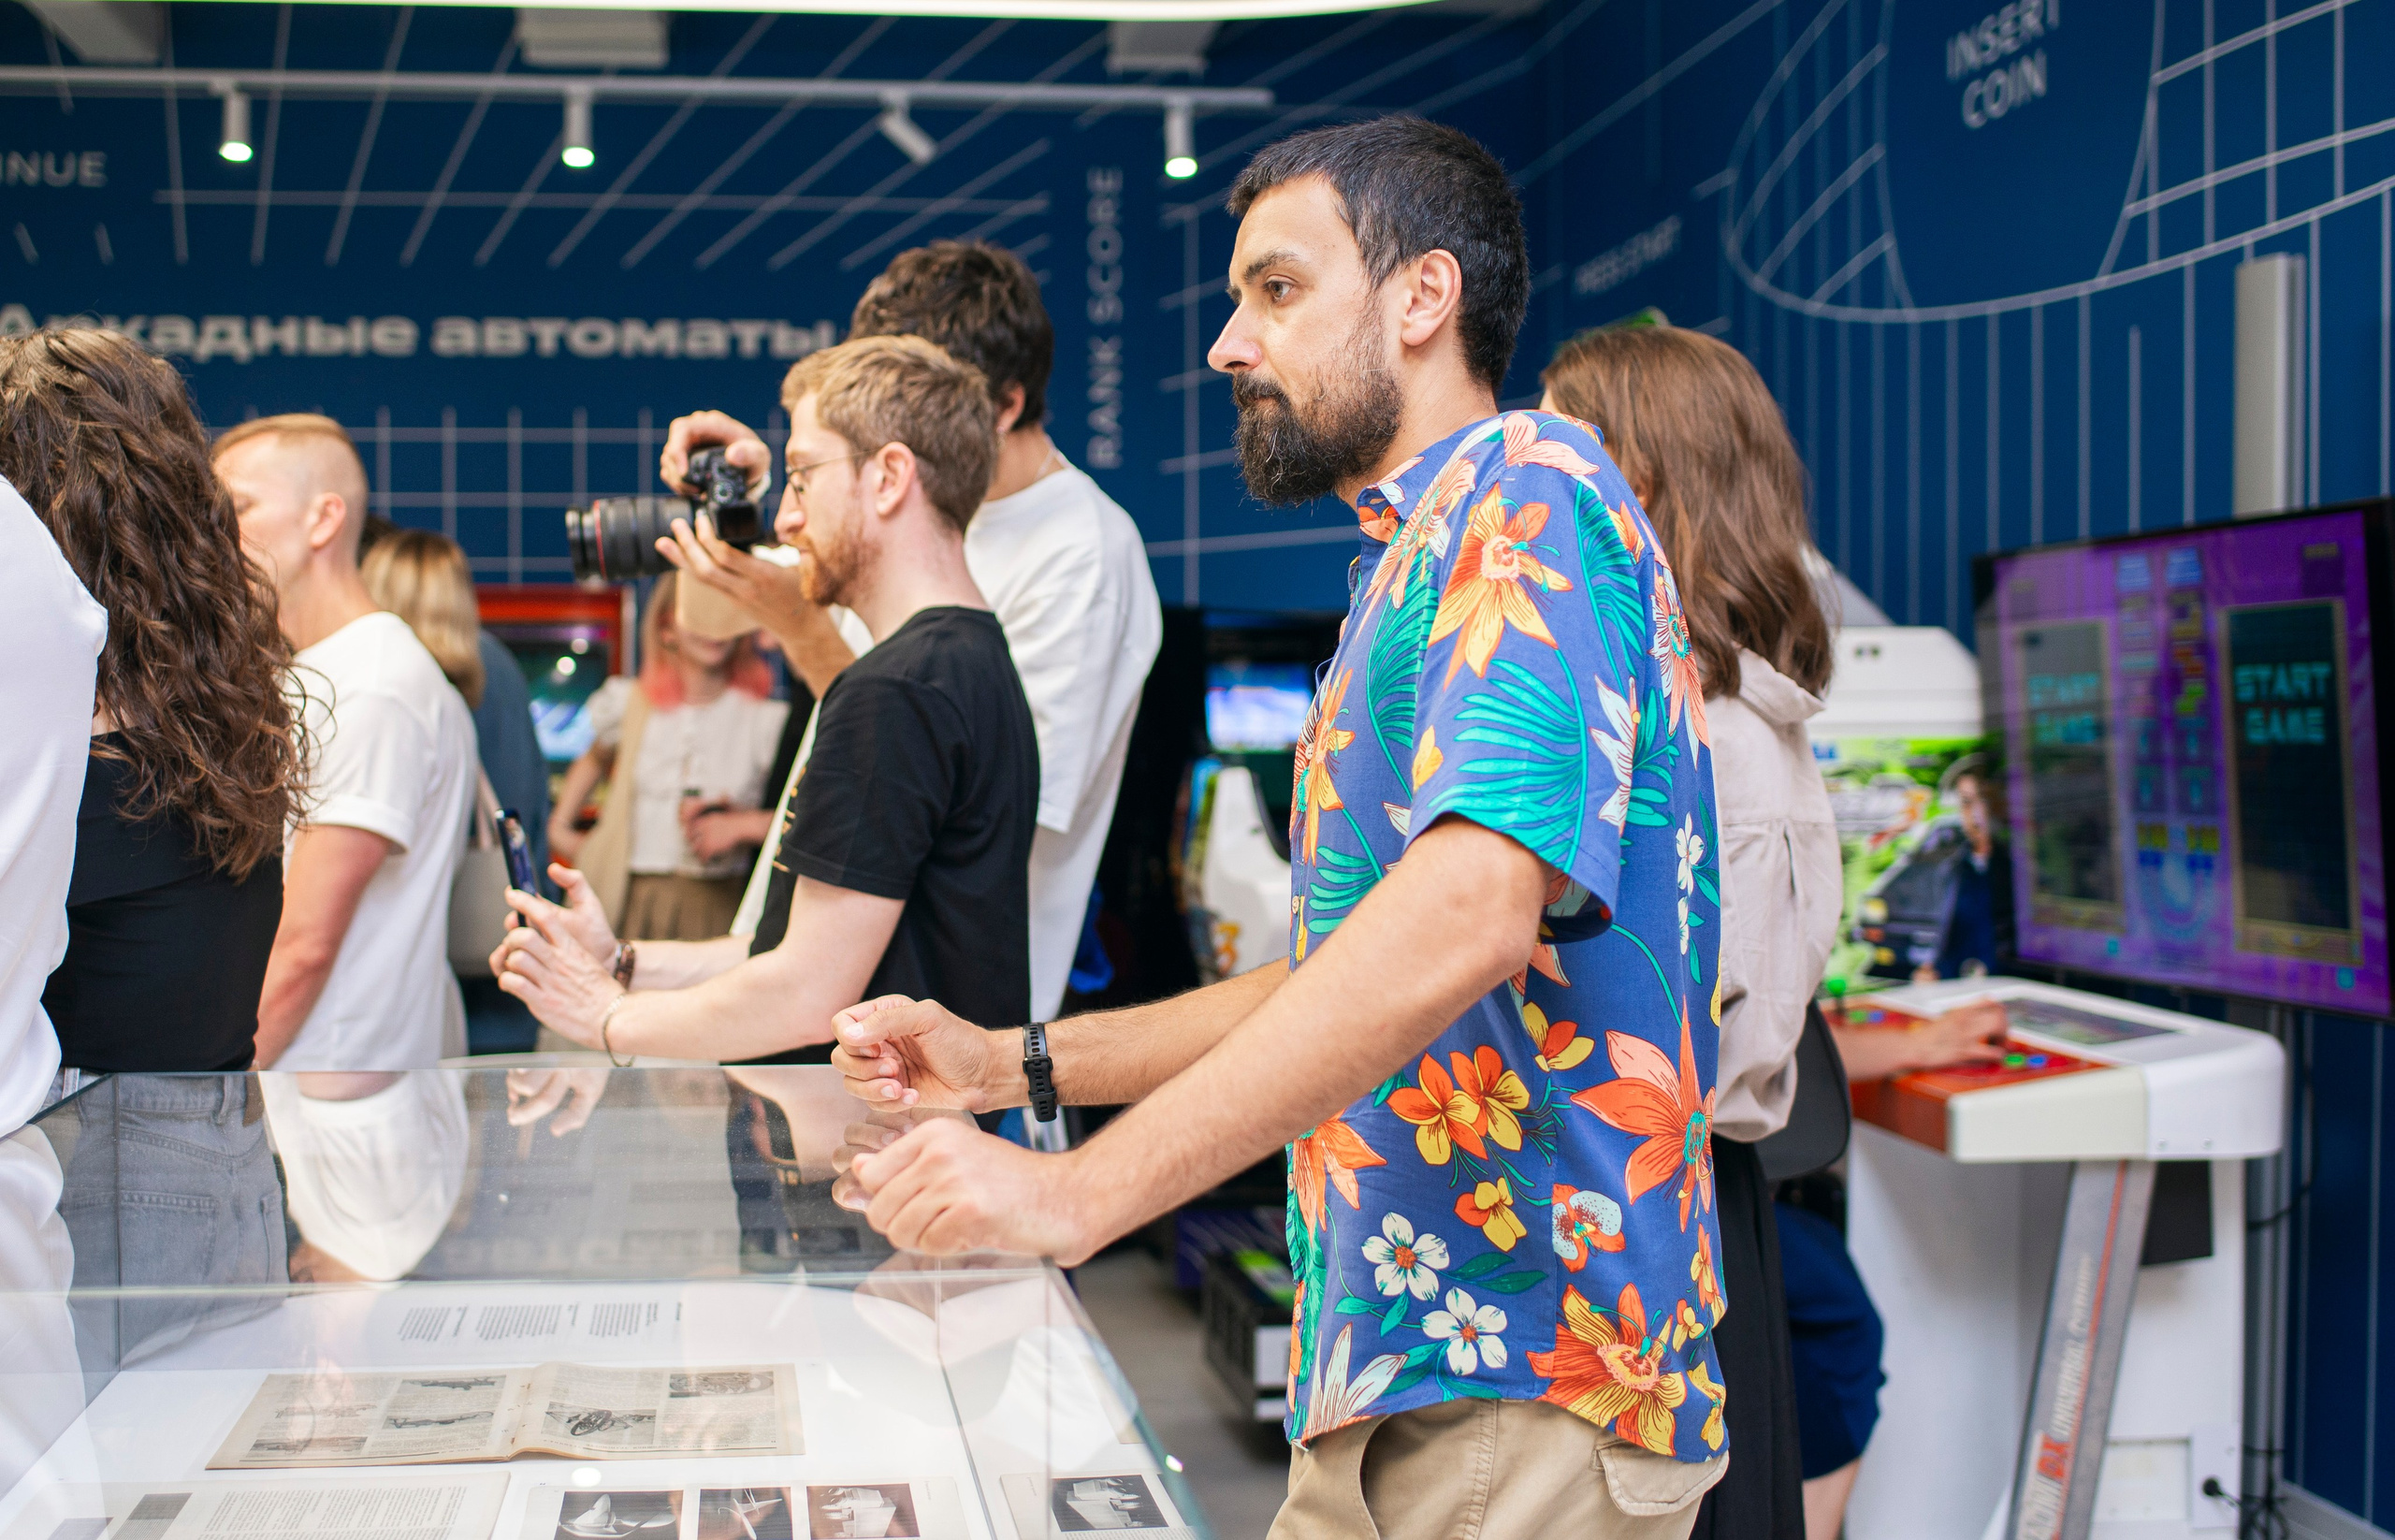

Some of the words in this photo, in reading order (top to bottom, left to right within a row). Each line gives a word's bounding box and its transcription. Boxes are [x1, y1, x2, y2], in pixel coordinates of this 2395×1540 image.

[1963, 48, 2047, 128] COIN
[0, 151, 108, 187] NUE
[1086, 167, 1124, 324] SCORE
[0, 302, 420, 363] Акадные
[429, 315, 835, 358] автоматы
[1086, 334, 1124, 470] RANK
[2234, 662, 2330, 703] START
